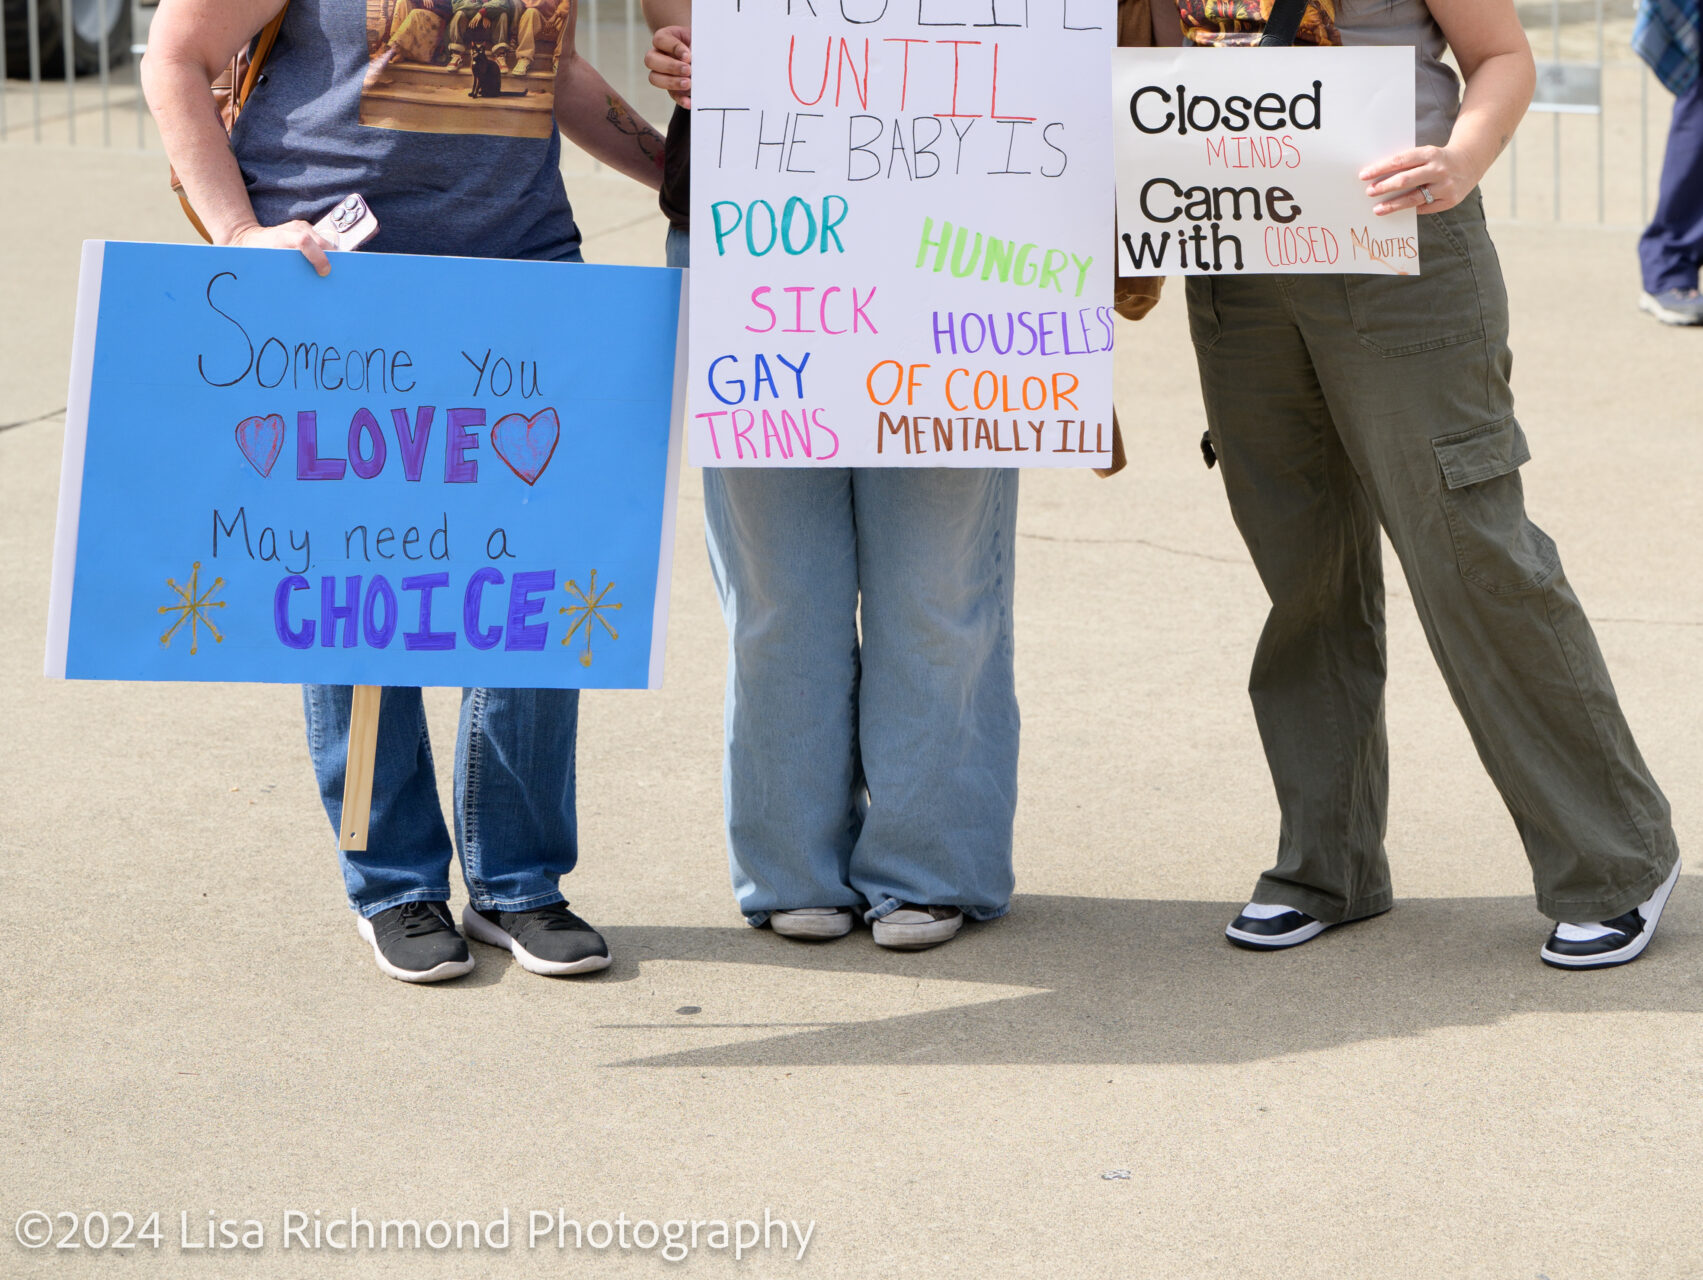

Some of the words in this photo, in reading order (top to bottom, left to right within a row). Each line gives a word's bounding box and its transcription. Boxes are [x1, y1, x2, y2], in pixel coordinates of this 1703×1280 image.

[788, 34, 1038, 121] UNTIL
[1129, 79, 1323, 136] Closed
[697, 108, 824, 173] THE
[847, 114, 976, 181] BABY
[986, 120, 1068, 178] IS
[1205, 134, 1302, 169] MINDS
[710, 194, 849, 256] POOR
[1139, 177, 1302, 224] Came
[914, 215, 1094, 297] HUNGRY
[1263, 225, 1340, 267] CLOSED
[198, 271, 417, 394] Someone
[744, 285, 879, 335] SICK
[931, 305, 1115, 356] HOUSELESS
[707, 351, 811, 406] GAY
[865, 359, 931, 406] OF
[944, 367, 1080, 412] COLOR
[296, 405, 488, 484] LOVE
[694, 407, 840, 462] TRANS
[876, 410, 1046, 455] MENTALLY
[1051, 418, 1112, 454] ILL
[212, 506, 314, 575] May
[345, 512, 452, 561] need
[486, 527, 517, 560] a
[273, 567, 557, 652] CHOICE
